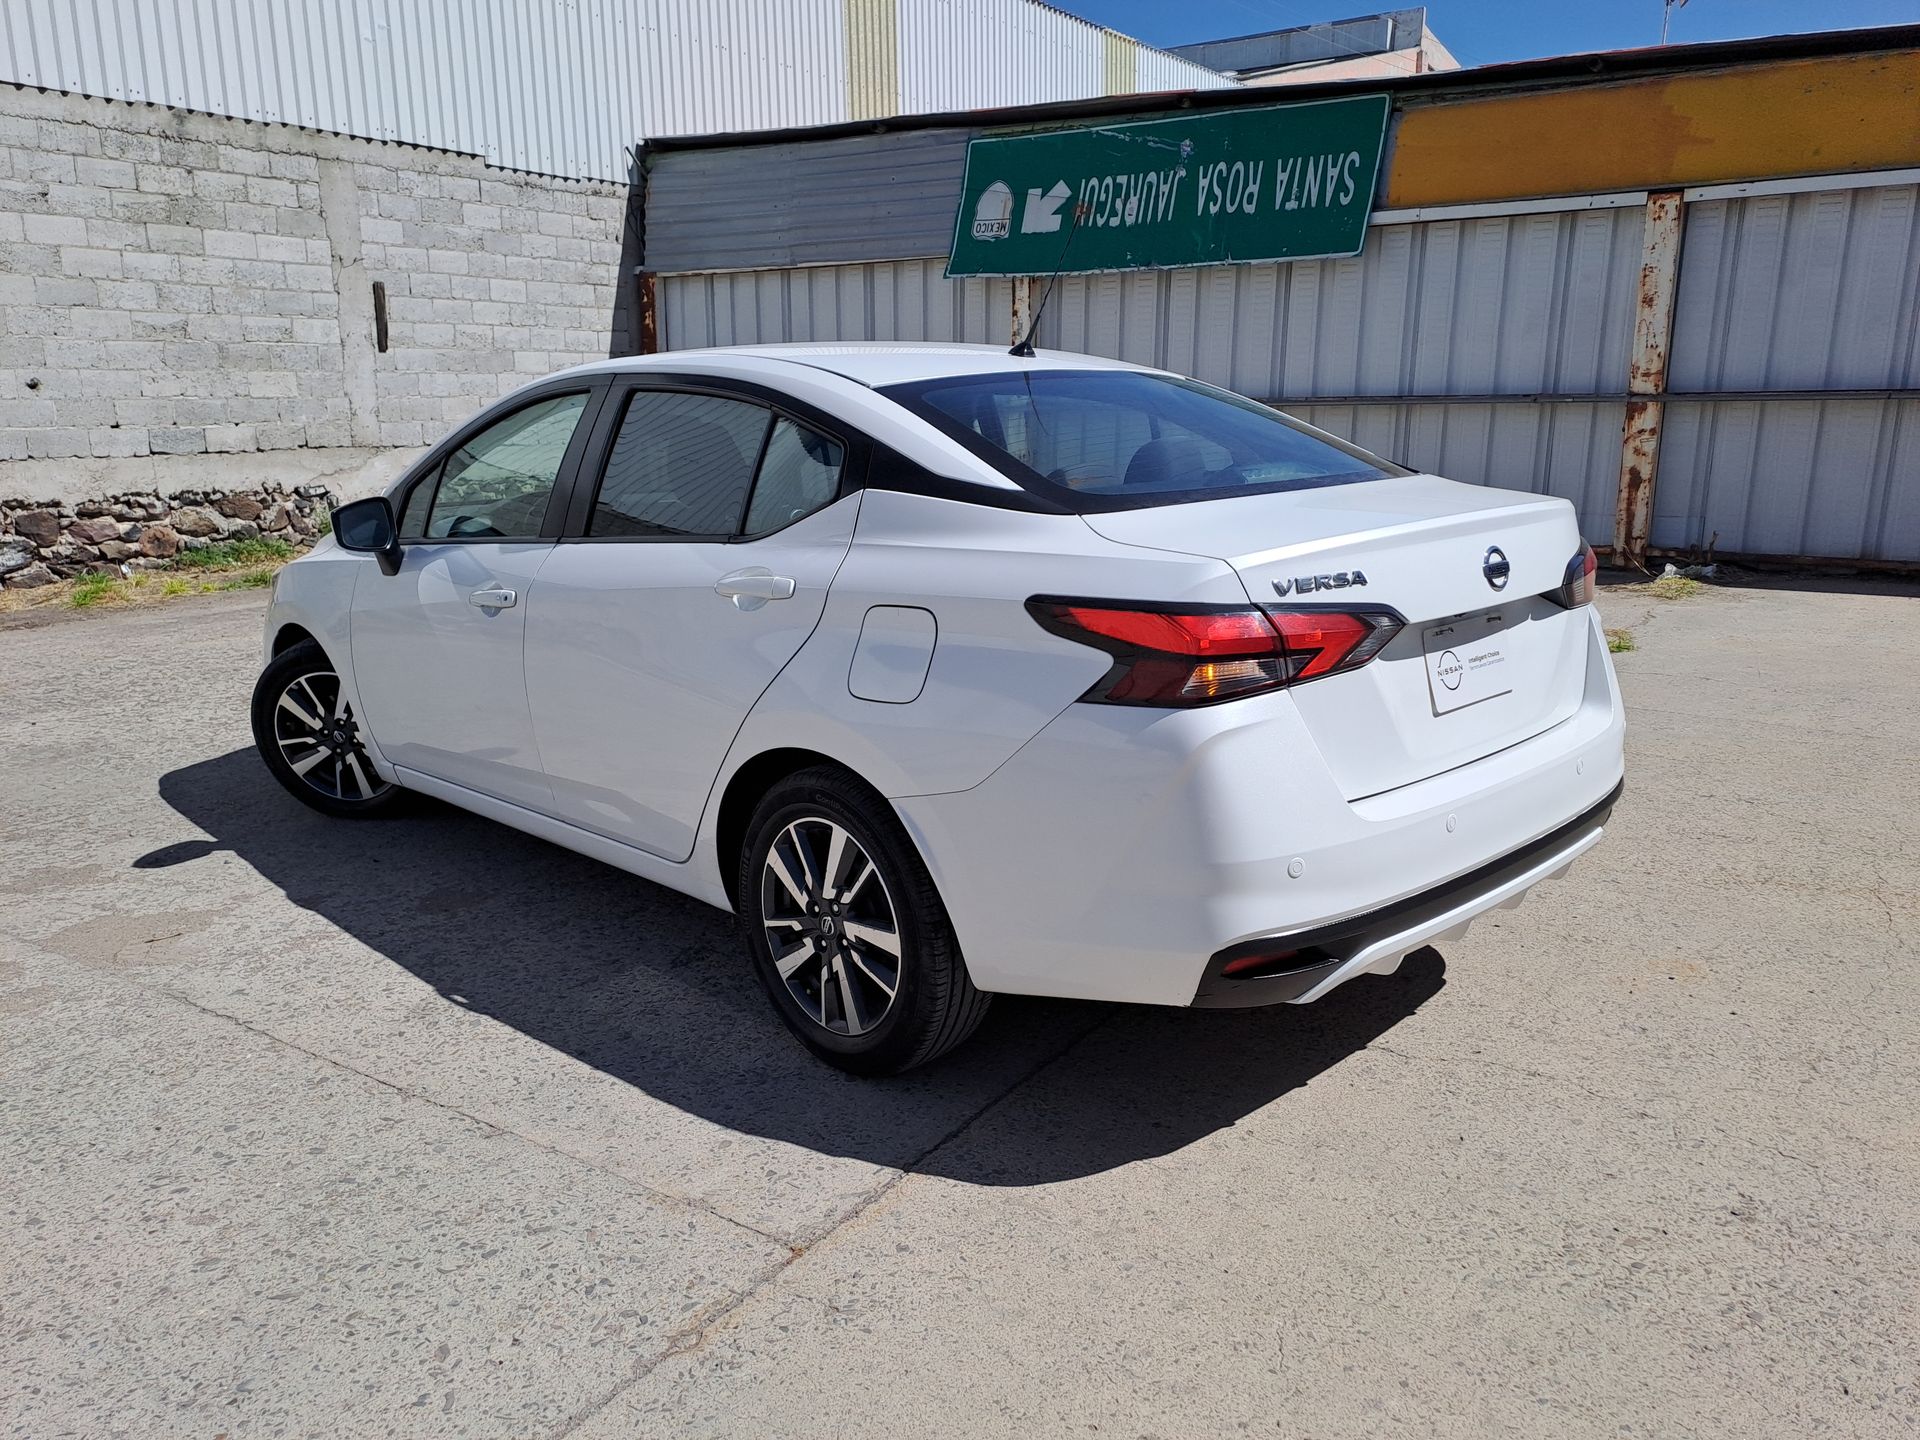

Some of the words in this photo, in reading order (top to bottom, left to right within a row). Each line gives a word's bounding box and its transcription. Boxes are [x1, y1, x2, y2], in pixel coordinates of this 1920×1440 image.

[1079, 168, 1186, 228] JAUREGUI
[1197, 160, 1264, 216] ROSA
[1275, 151, 1360, 212] SANTA
[975, 221, 1008, 235] MEXICO
[1272, 570, 1368, 597] VERSA
[1437, 664, 1463, 677] NISSAN
